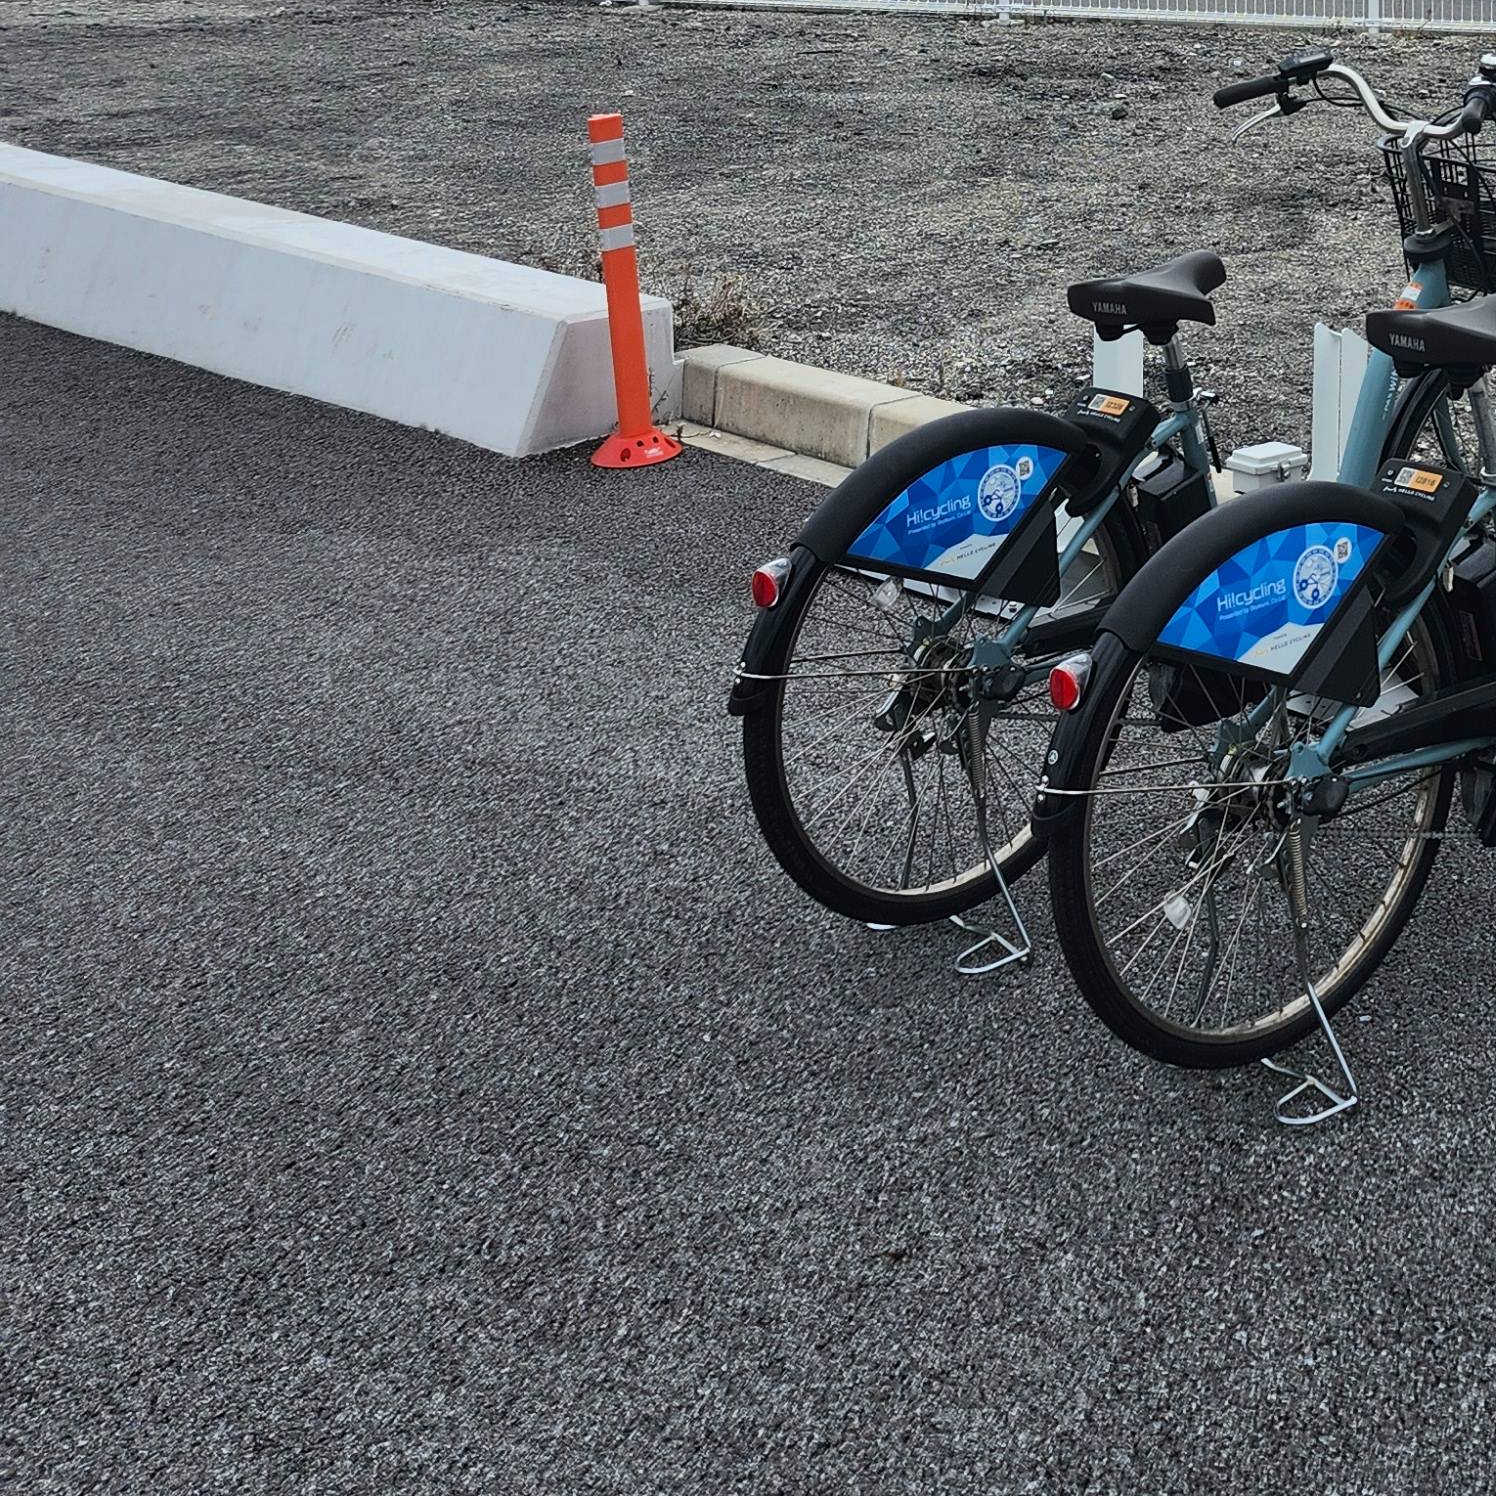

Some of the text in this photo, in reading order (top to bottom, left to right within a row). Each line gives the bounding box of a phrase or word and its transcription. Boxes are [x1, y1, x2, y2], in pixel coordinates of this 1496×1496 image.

[1091, 301, 1127, 315] YAMAHA
[1388, 332, 1426, 353] YAMAHA
[905, 494, 972, 528] Hi!cycling
[1216, 577, 1287, 613] Hi!cycling
